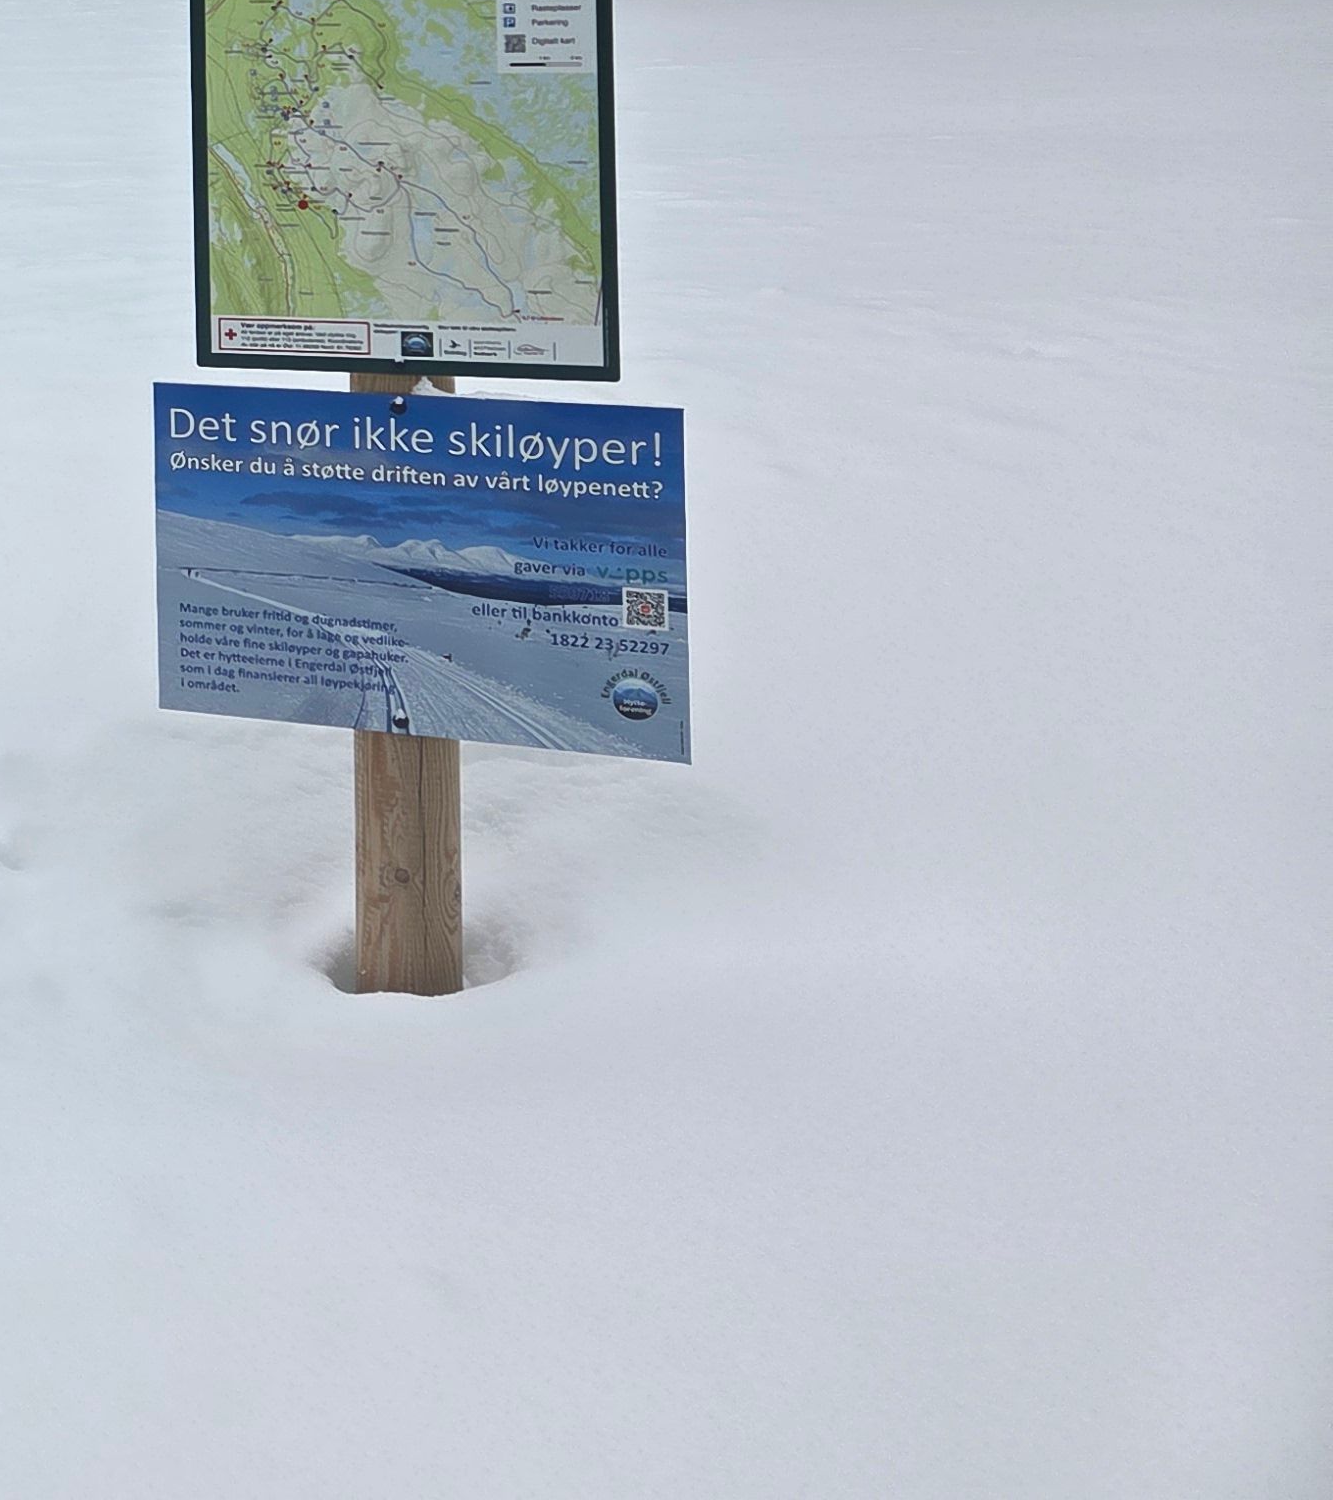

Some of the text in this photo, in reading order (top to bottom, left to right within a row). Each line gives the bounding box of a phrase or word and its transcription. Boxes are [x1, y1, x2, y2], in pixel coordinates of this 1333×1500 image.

[169, 407, 662, 471] Det snør ikke skiløyper!
[170, 450, 663, 499] Ønsker du å støtte driften av vårt løypenett?
[532, 536, 667, 558] Vi takker for alle
[514, 561, 558, 575] gaver
[562, 563, 586, 576] via
[179, 603, 397, 632] Mange bruker fritid og dugnadstimer,
[472, 603, 619, 627] eller til bankkonto
[179, 619, 226, 631] sommer
[229, 624, 244, 635] og
[246, 624, 283, 638] vinter,
[286, 627, 304, 638] for
[316, 630, 341, 643] lage
[344, 634, 359, 646] og
[362, 635, 410, 647] vedlike-
[550, 633, 670, 656] 1822 23 52297
[180, 632, 408, 663] holde våre fine skiløyper og gapahuker.
[181, 648, 201, 658] Det
[203, 651, 215, 660] er
[294, 659, 346, 672] Engerdal
[180, 664, 204, 674] som
[214, 666, 235, 679] dag
[238, 668, 300, 684] finansierer
[303, 675, 317, 685] all
[187, 679, 240, 693] området.
